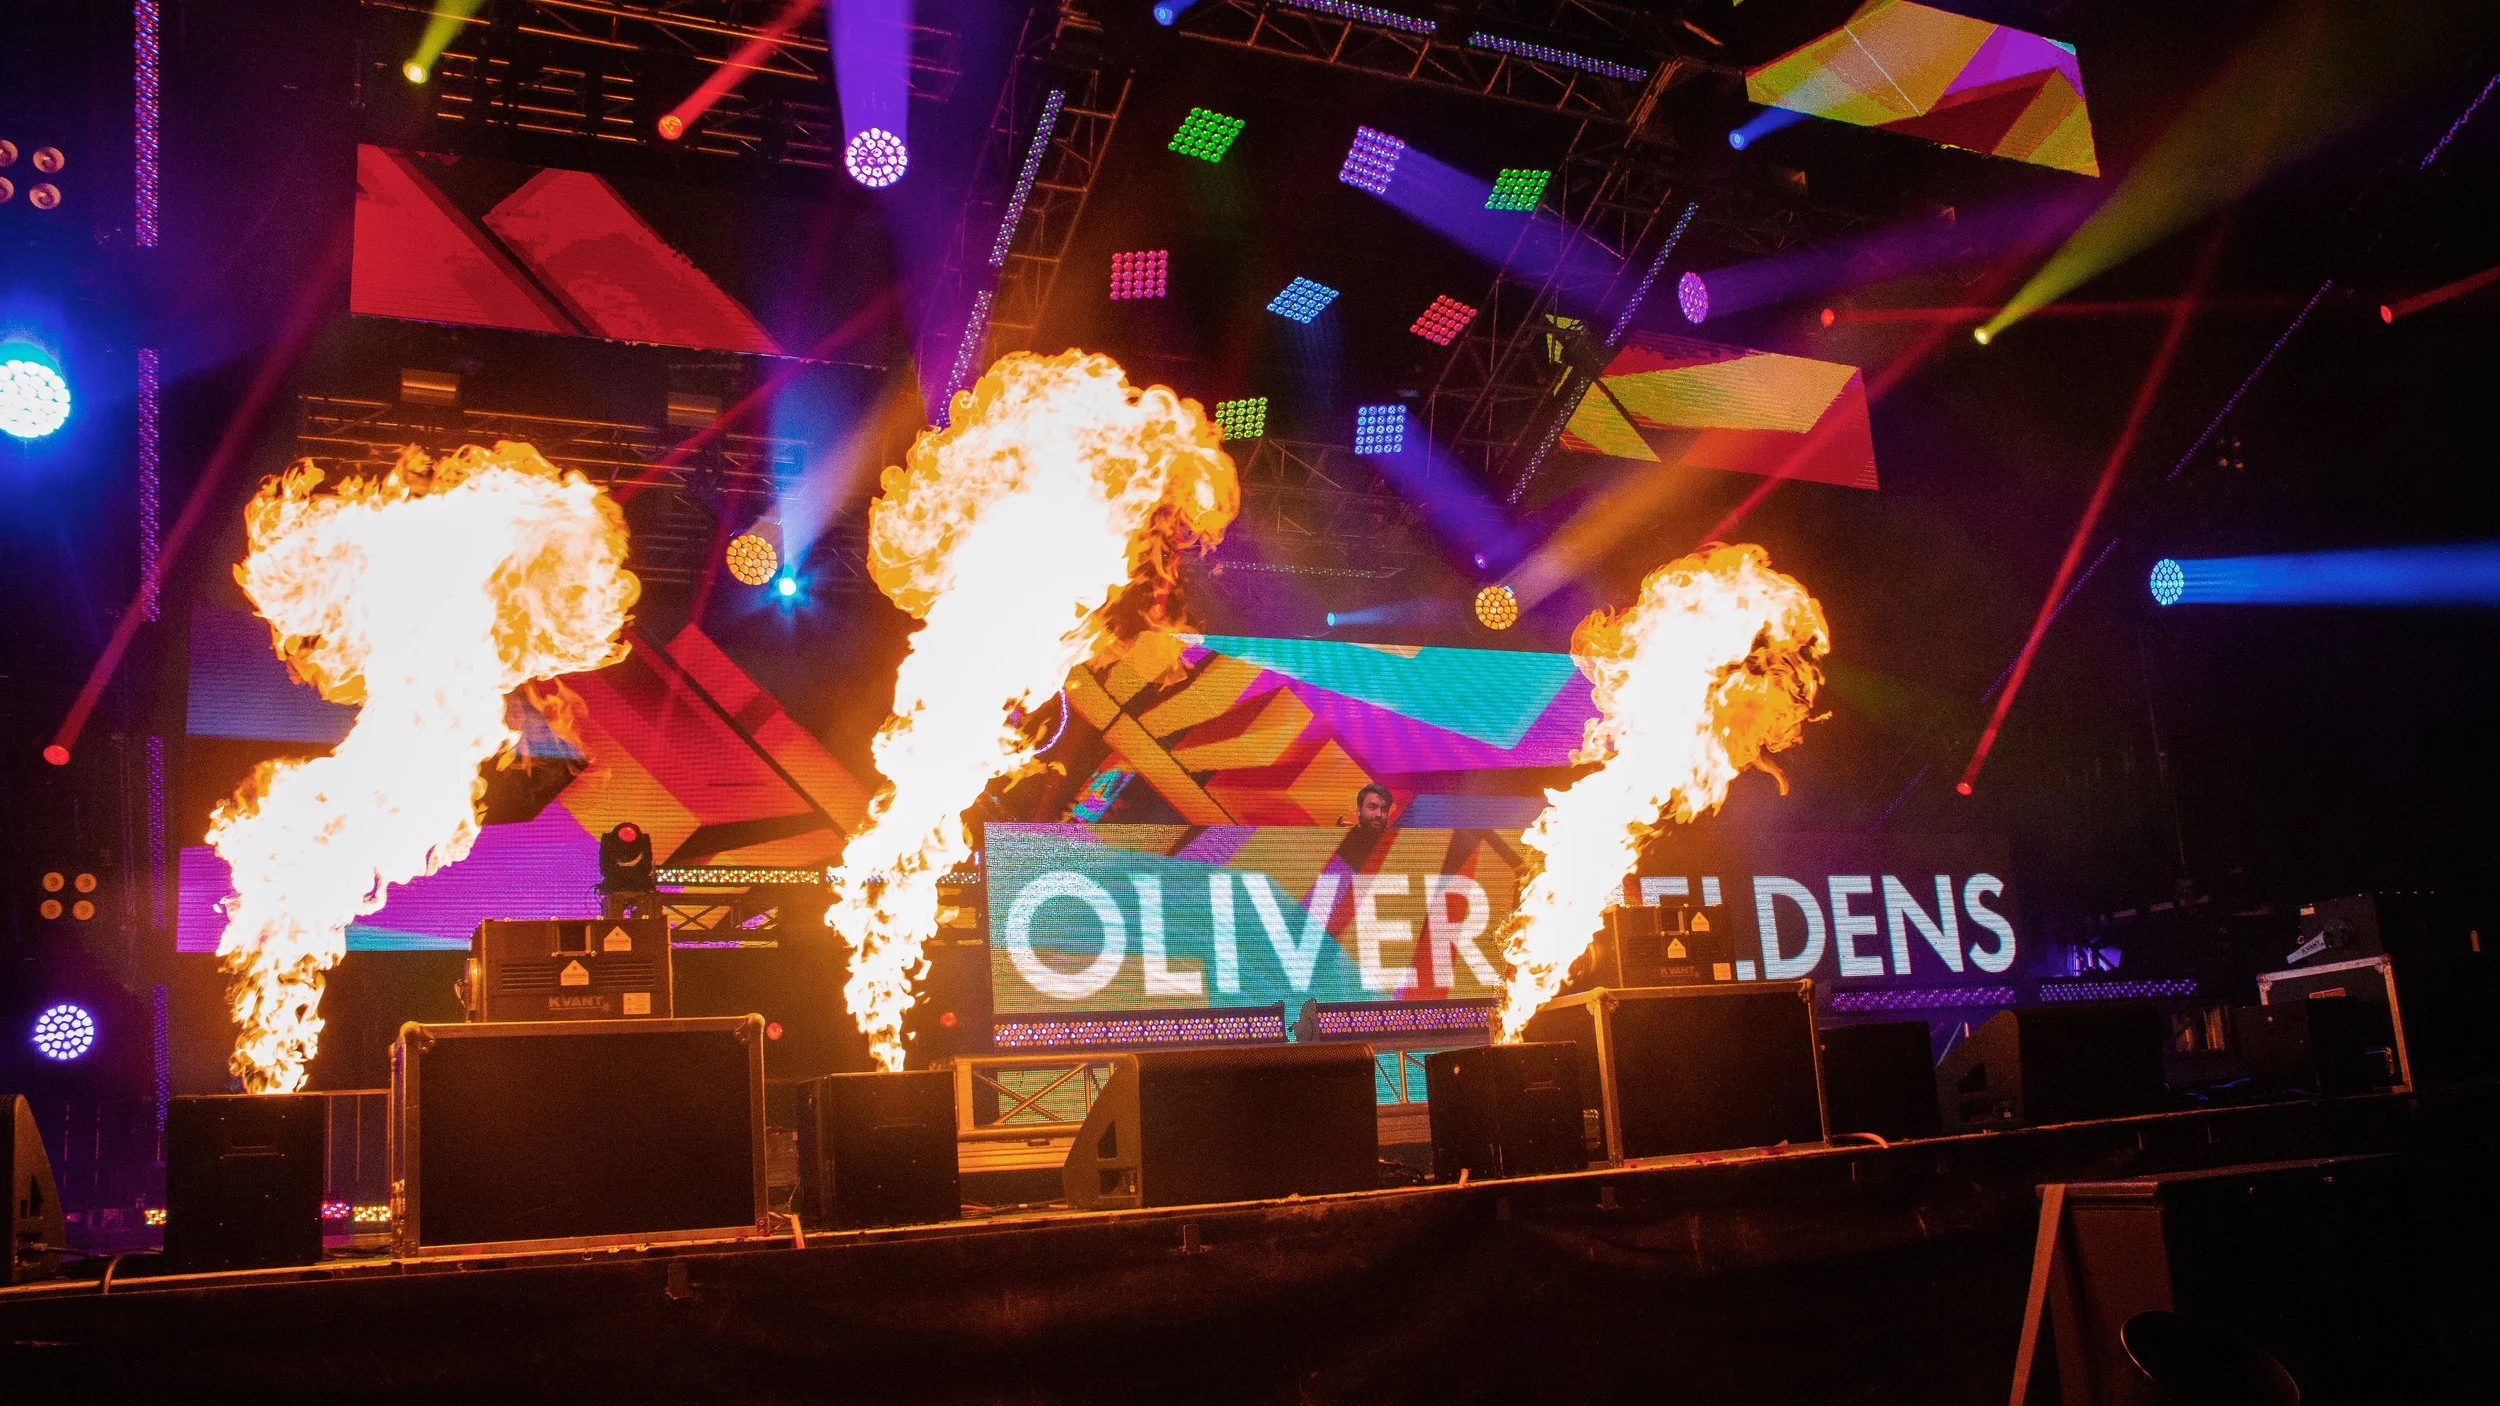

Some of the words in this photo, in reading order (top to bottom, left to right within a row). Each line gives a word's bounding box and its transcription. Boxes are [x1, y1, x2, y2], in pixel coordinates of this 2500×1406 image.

[1005, 870, 1502, 999] OLIVER
[1609, 872, 2017, 981] DENS
[1660, 966, 1696, 976] KVANT
[550, 995, 603, 1007] KVANT
